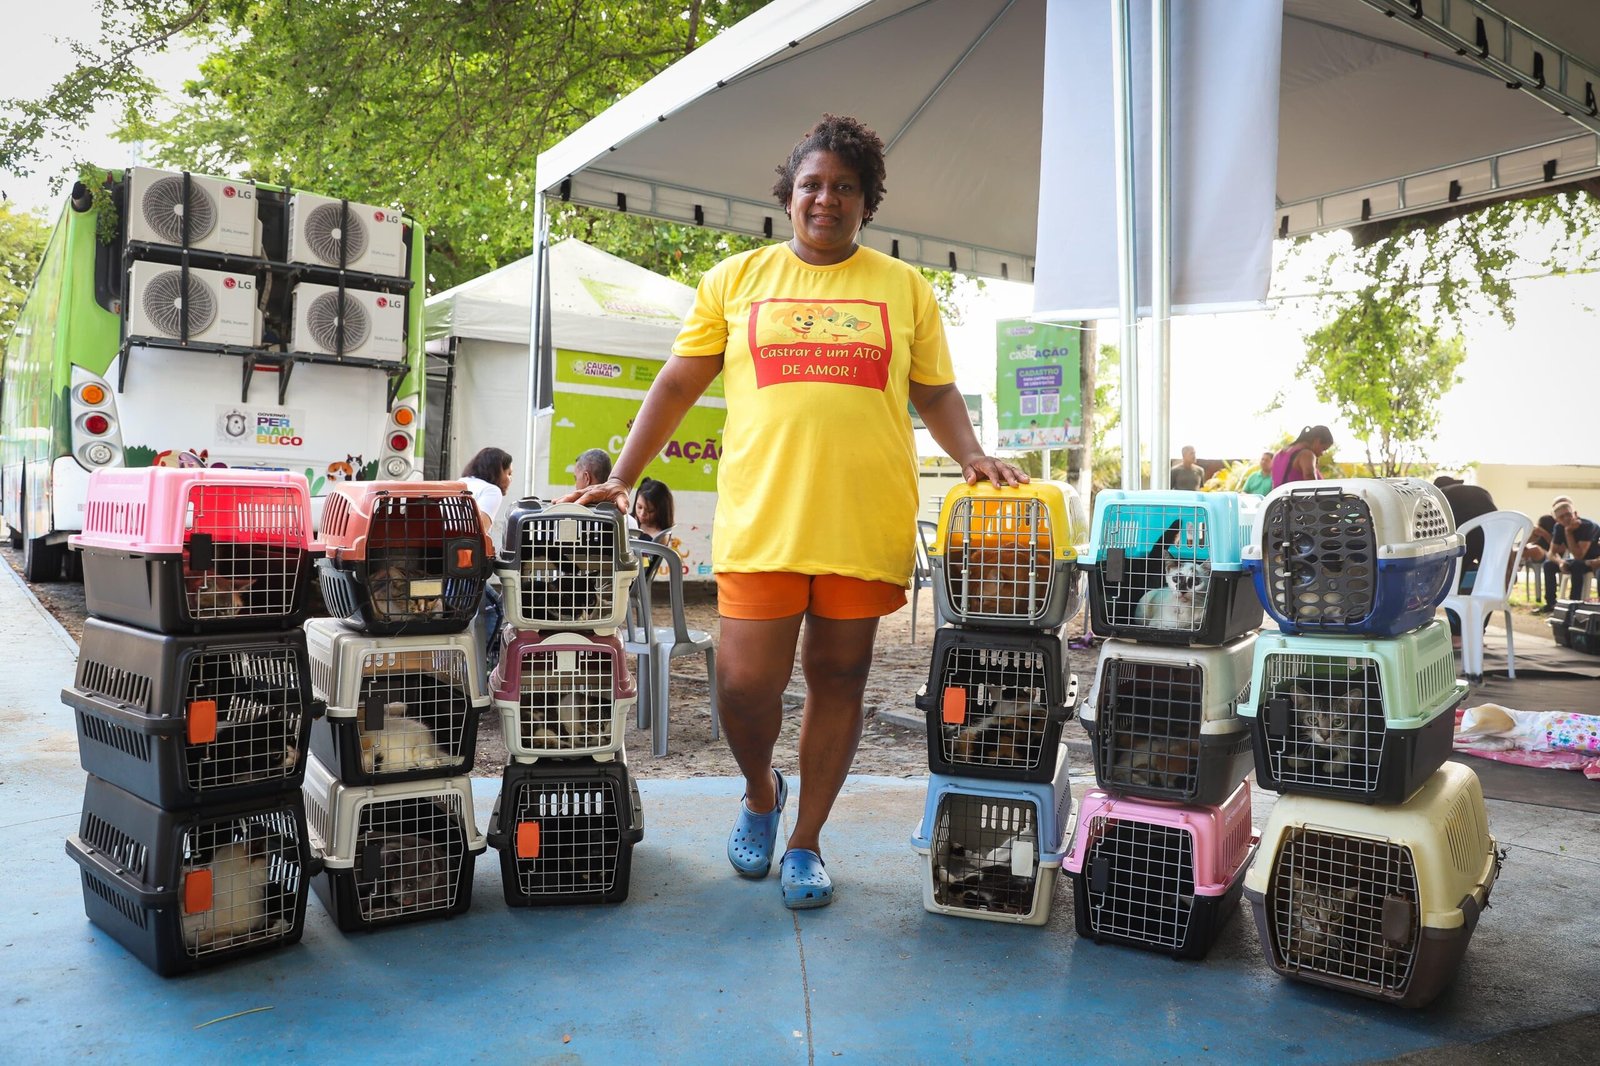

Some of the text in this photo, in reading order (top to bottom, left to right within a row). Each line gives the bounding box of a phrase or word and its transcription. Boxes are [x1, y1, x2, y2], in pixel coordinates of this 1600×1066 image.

[237, 189, 252, 199] LG
[386, 214, 399, 224] LG
[238, 280, 252, 290] LG
[389, 300, 401, 308] LG
[760, 347, 882, 361] Castrar é um ATO
[587, 362, 613, 370] CAUSA
[782, 364, 801, 375] DE
[804, 365, 849, 377] AMOR
[585, 368, 613, 377] ANIMAL
[1019, 368, 1059, 377] CADASTRO
[257, 417, 290, 427] PER
[257, 426, 294, 436] NAM
[256, 435, 303, 446] BUCO
